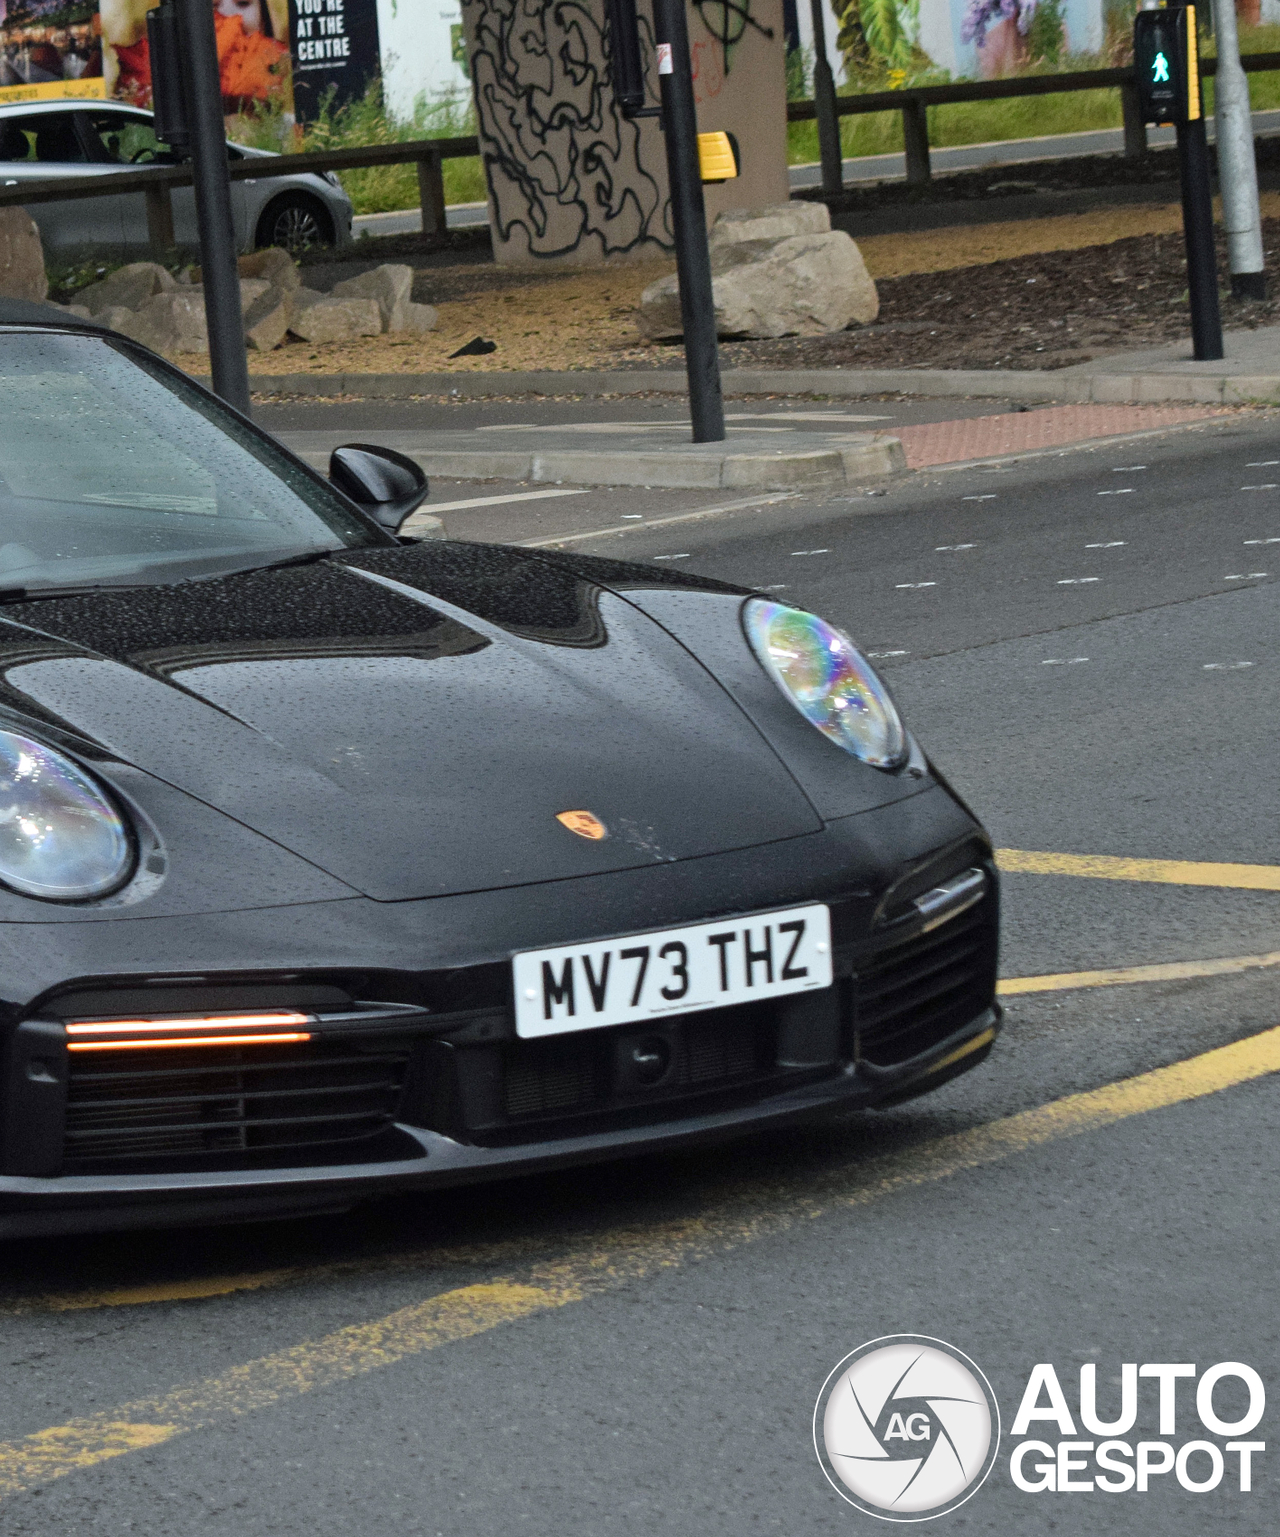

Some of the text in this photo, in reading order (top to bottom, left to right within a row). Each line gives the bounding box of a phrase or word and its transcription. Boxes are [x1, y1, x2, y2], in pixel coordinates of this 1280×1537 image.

[294, 0, 345, 15] YOURE
[297, 14, 345, 38] AT THE
[298, 36, 351, 61] CENTRE
[541, 918, 809, 1020] MV73 THZ
